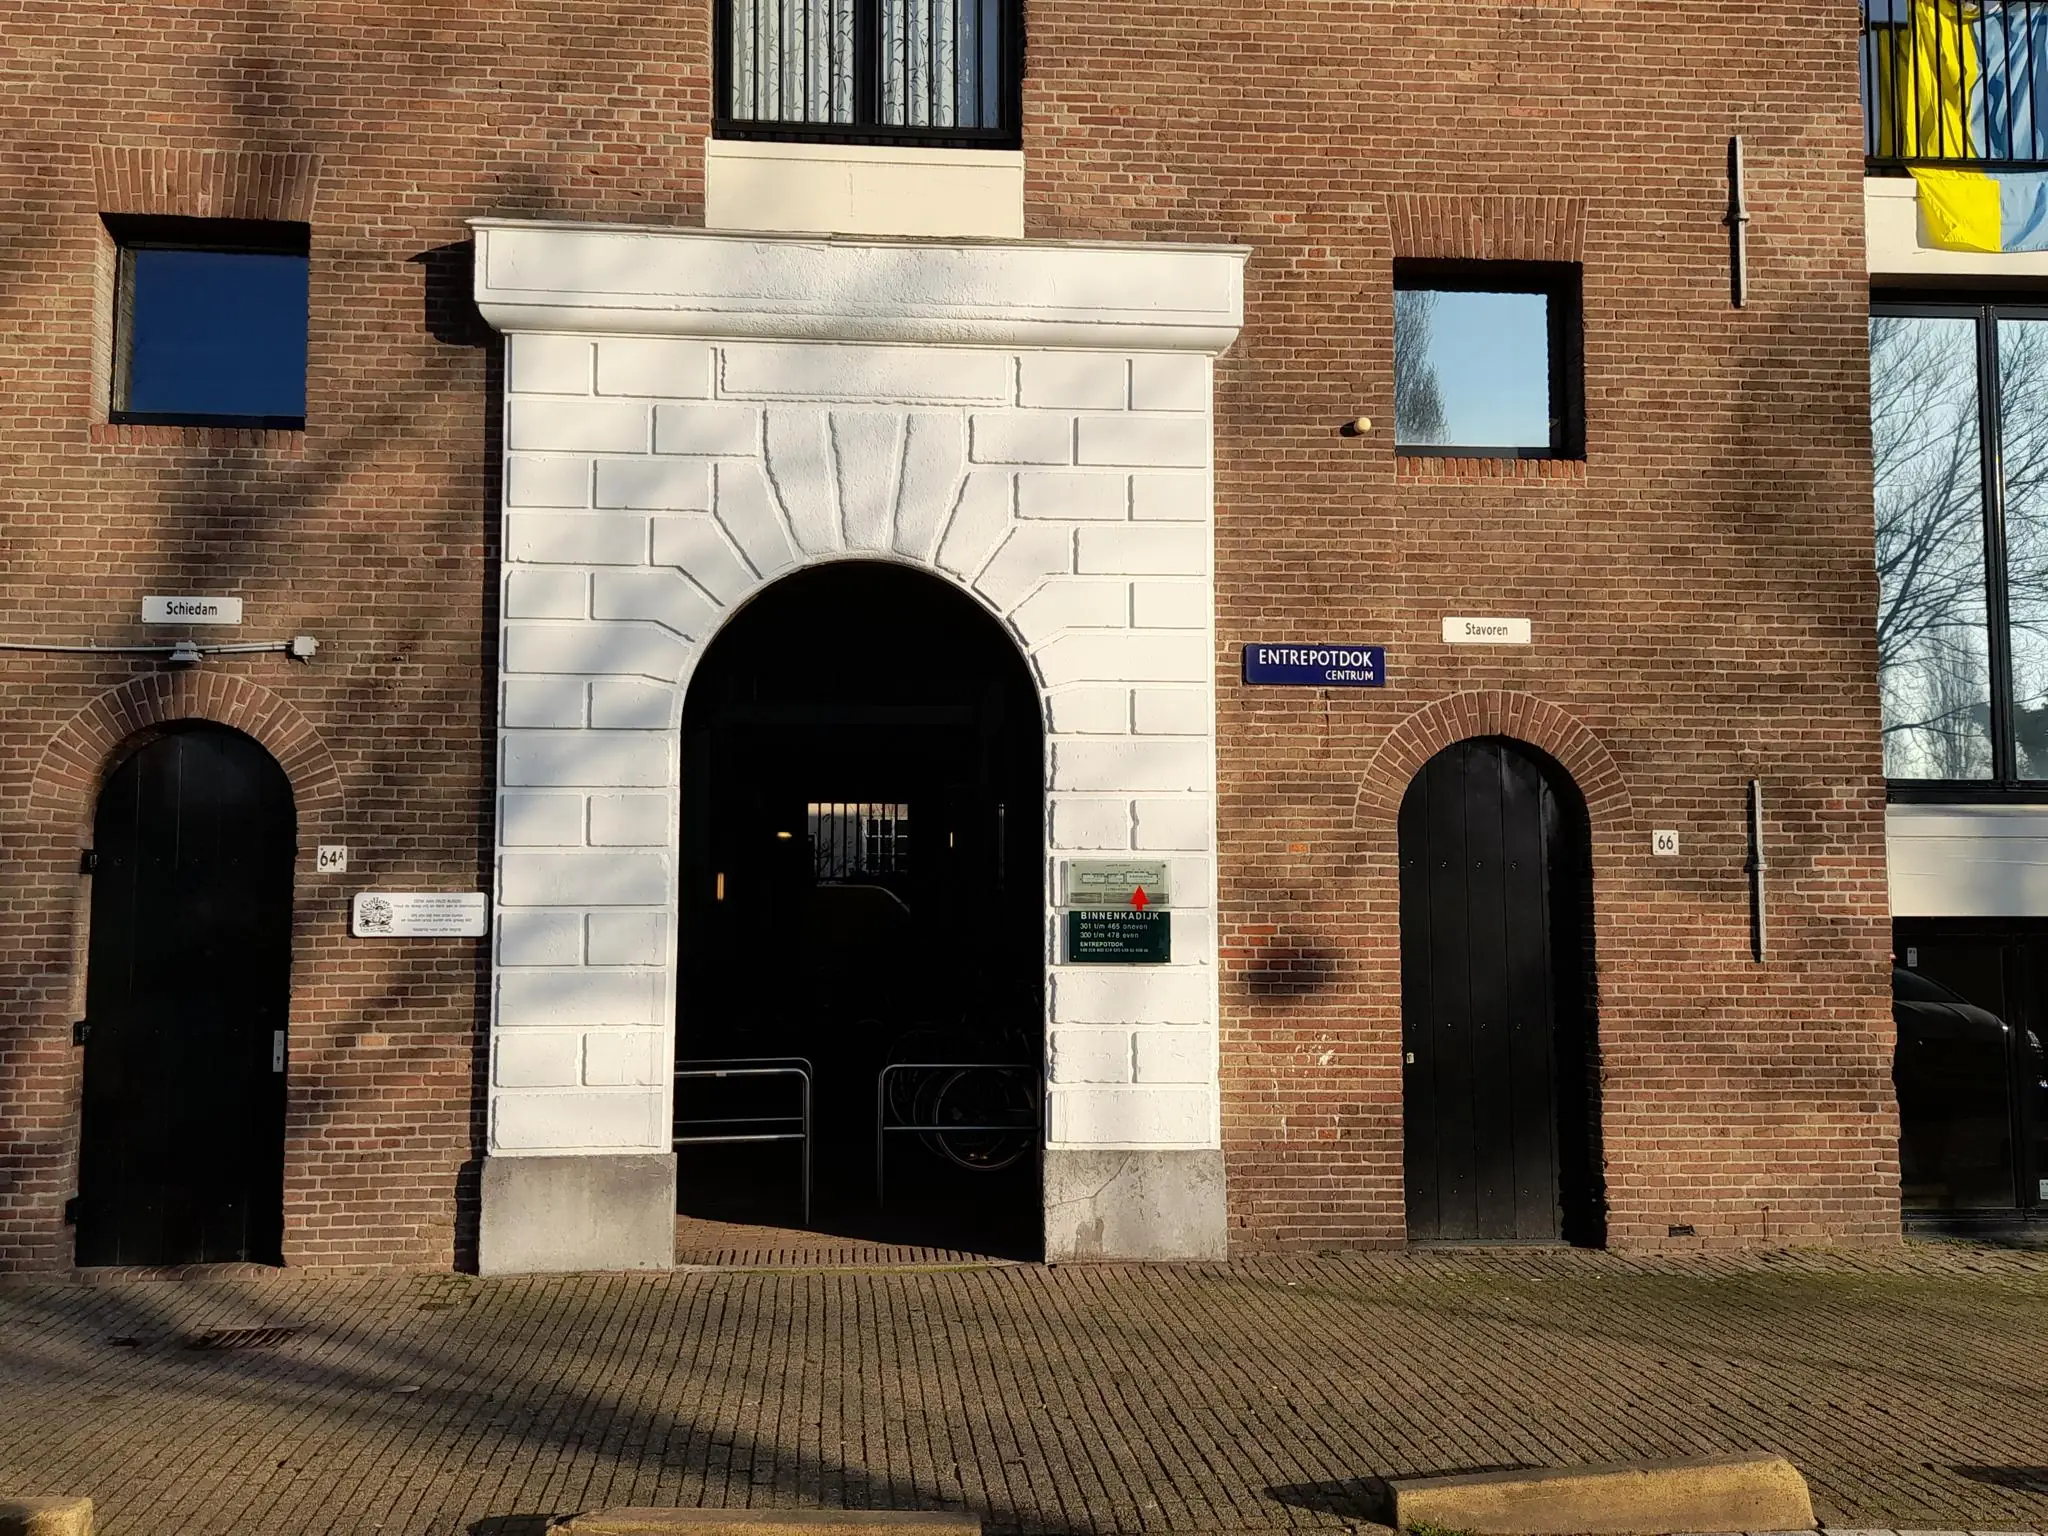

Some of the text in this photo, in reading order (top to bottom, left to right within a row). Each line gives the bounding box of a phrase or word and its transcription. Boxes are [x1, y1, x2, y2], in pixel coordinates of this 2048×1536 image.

[166, 601, 218, 616] Schiedam
[1465, 622, 1508, 636] Stavoren
[1259, 649, 1373, 667] ENTREPOTDOK
[1325, 670, 1374, 681] CENTRUM
[1658, 835, 1674, 850] 66
[1080, 911, 1160, 920] BINNENKADIJK
[1080, 922, 1092, 930] 301
[1093, 922, 1106, 930] t/m
[1080, 931, 1092, 939] 300
[1093, 931, 1105, 939] t/m
